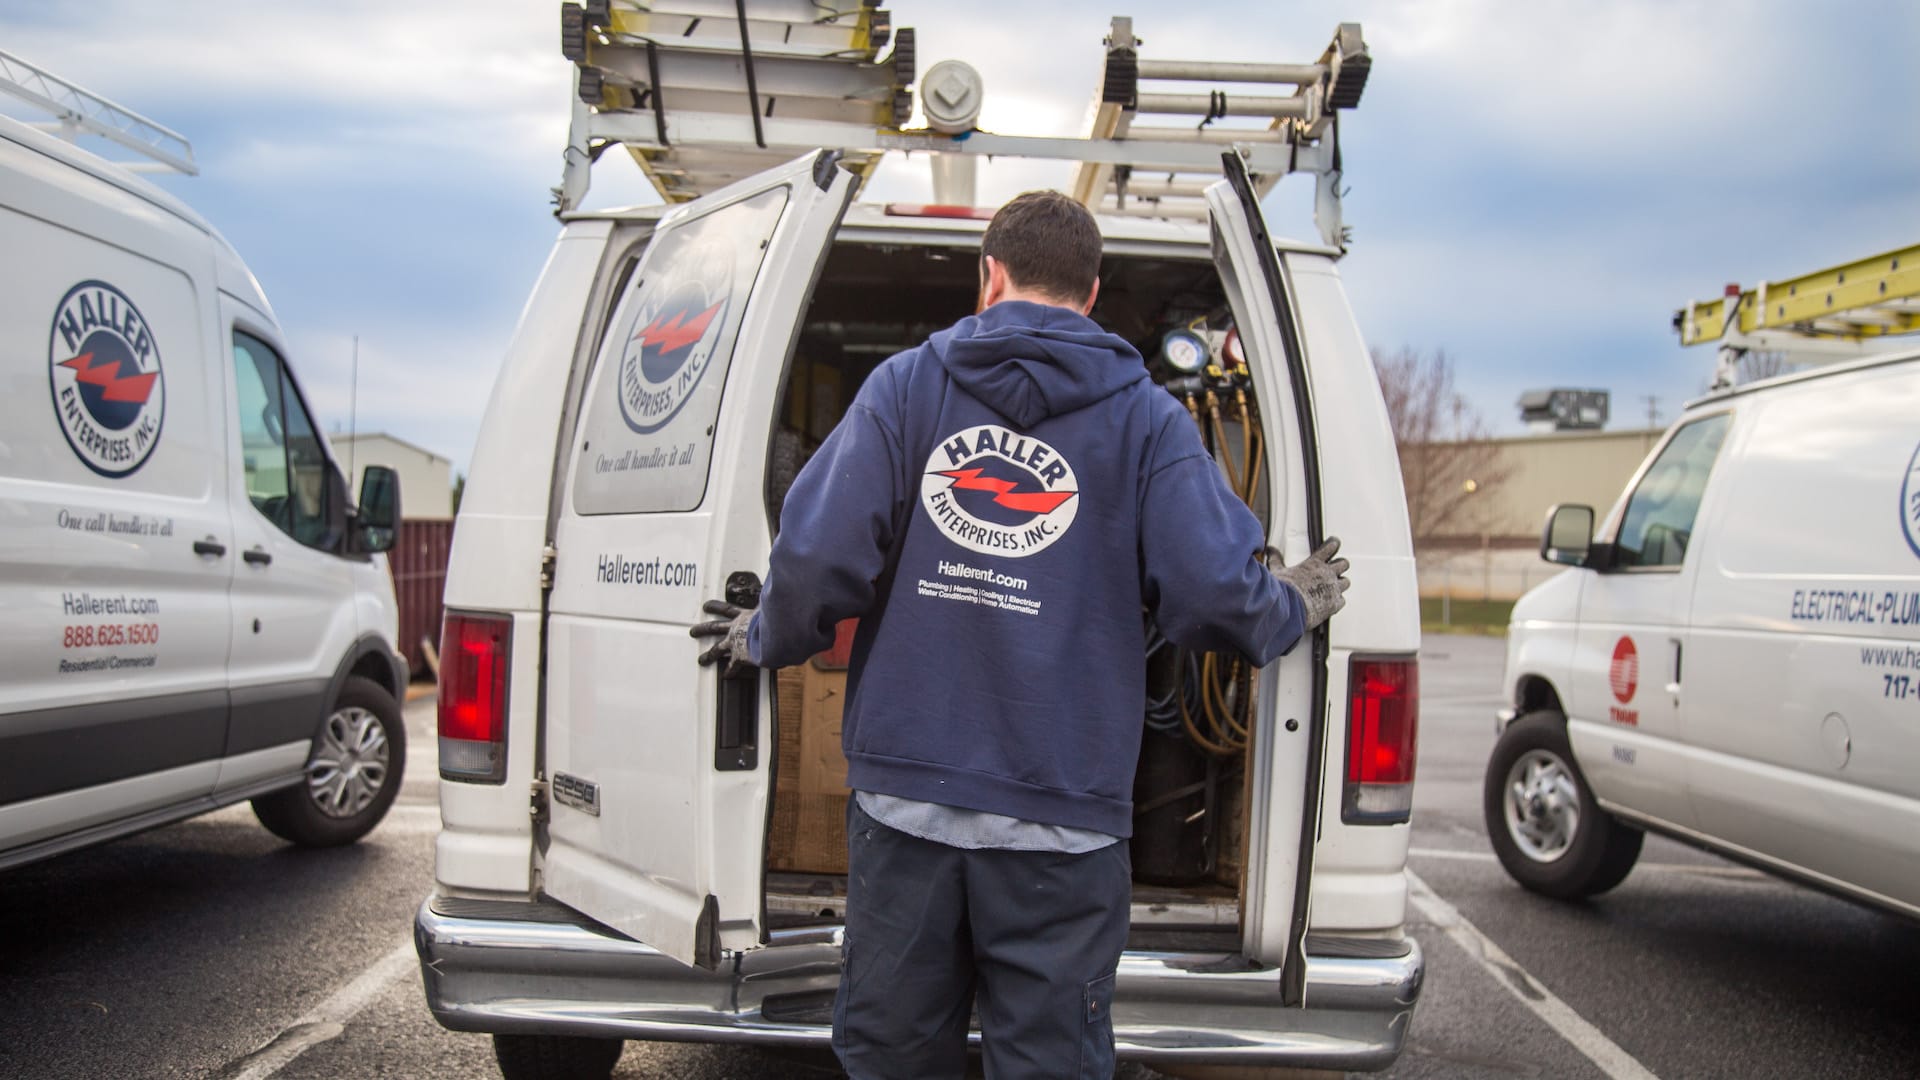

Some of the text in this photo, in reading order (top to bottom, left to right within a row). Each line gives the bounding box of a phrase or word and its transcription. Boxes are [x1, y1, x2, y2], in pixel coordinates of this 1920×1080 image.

[58, 290, 151, 371] HALLER
[678, 353, 706, 397] INC.
[136, 418, 158, 451] INC.
[595, 443, 696, 474] One call handles it all
[943, 428, 1067, 488] HALLER
[58, 509, 174, 537] One call handles it all
[1025, 520, 1058, 548] INC.
[597, 554, 697, 587] Hallerent.com
[937, 560, 1028, 590] Hallerent.com
[62, 592, 160, 616] Hallerent.com
[917, 587, 938, 597] Water
[938, 591, 978, 604] Conditioning
[998, 601, 1039, 616] Automation
[918, 579, 950, 593] Plumbing
[953, 585, 979, 596] Heating
[981, 589, 1004, 602] Cooling
[1008, 595, 1042, 609] Electrical
[63, 623, 159, 648] 888.625.1500
[1883, 674, 1920, 701] 717-
